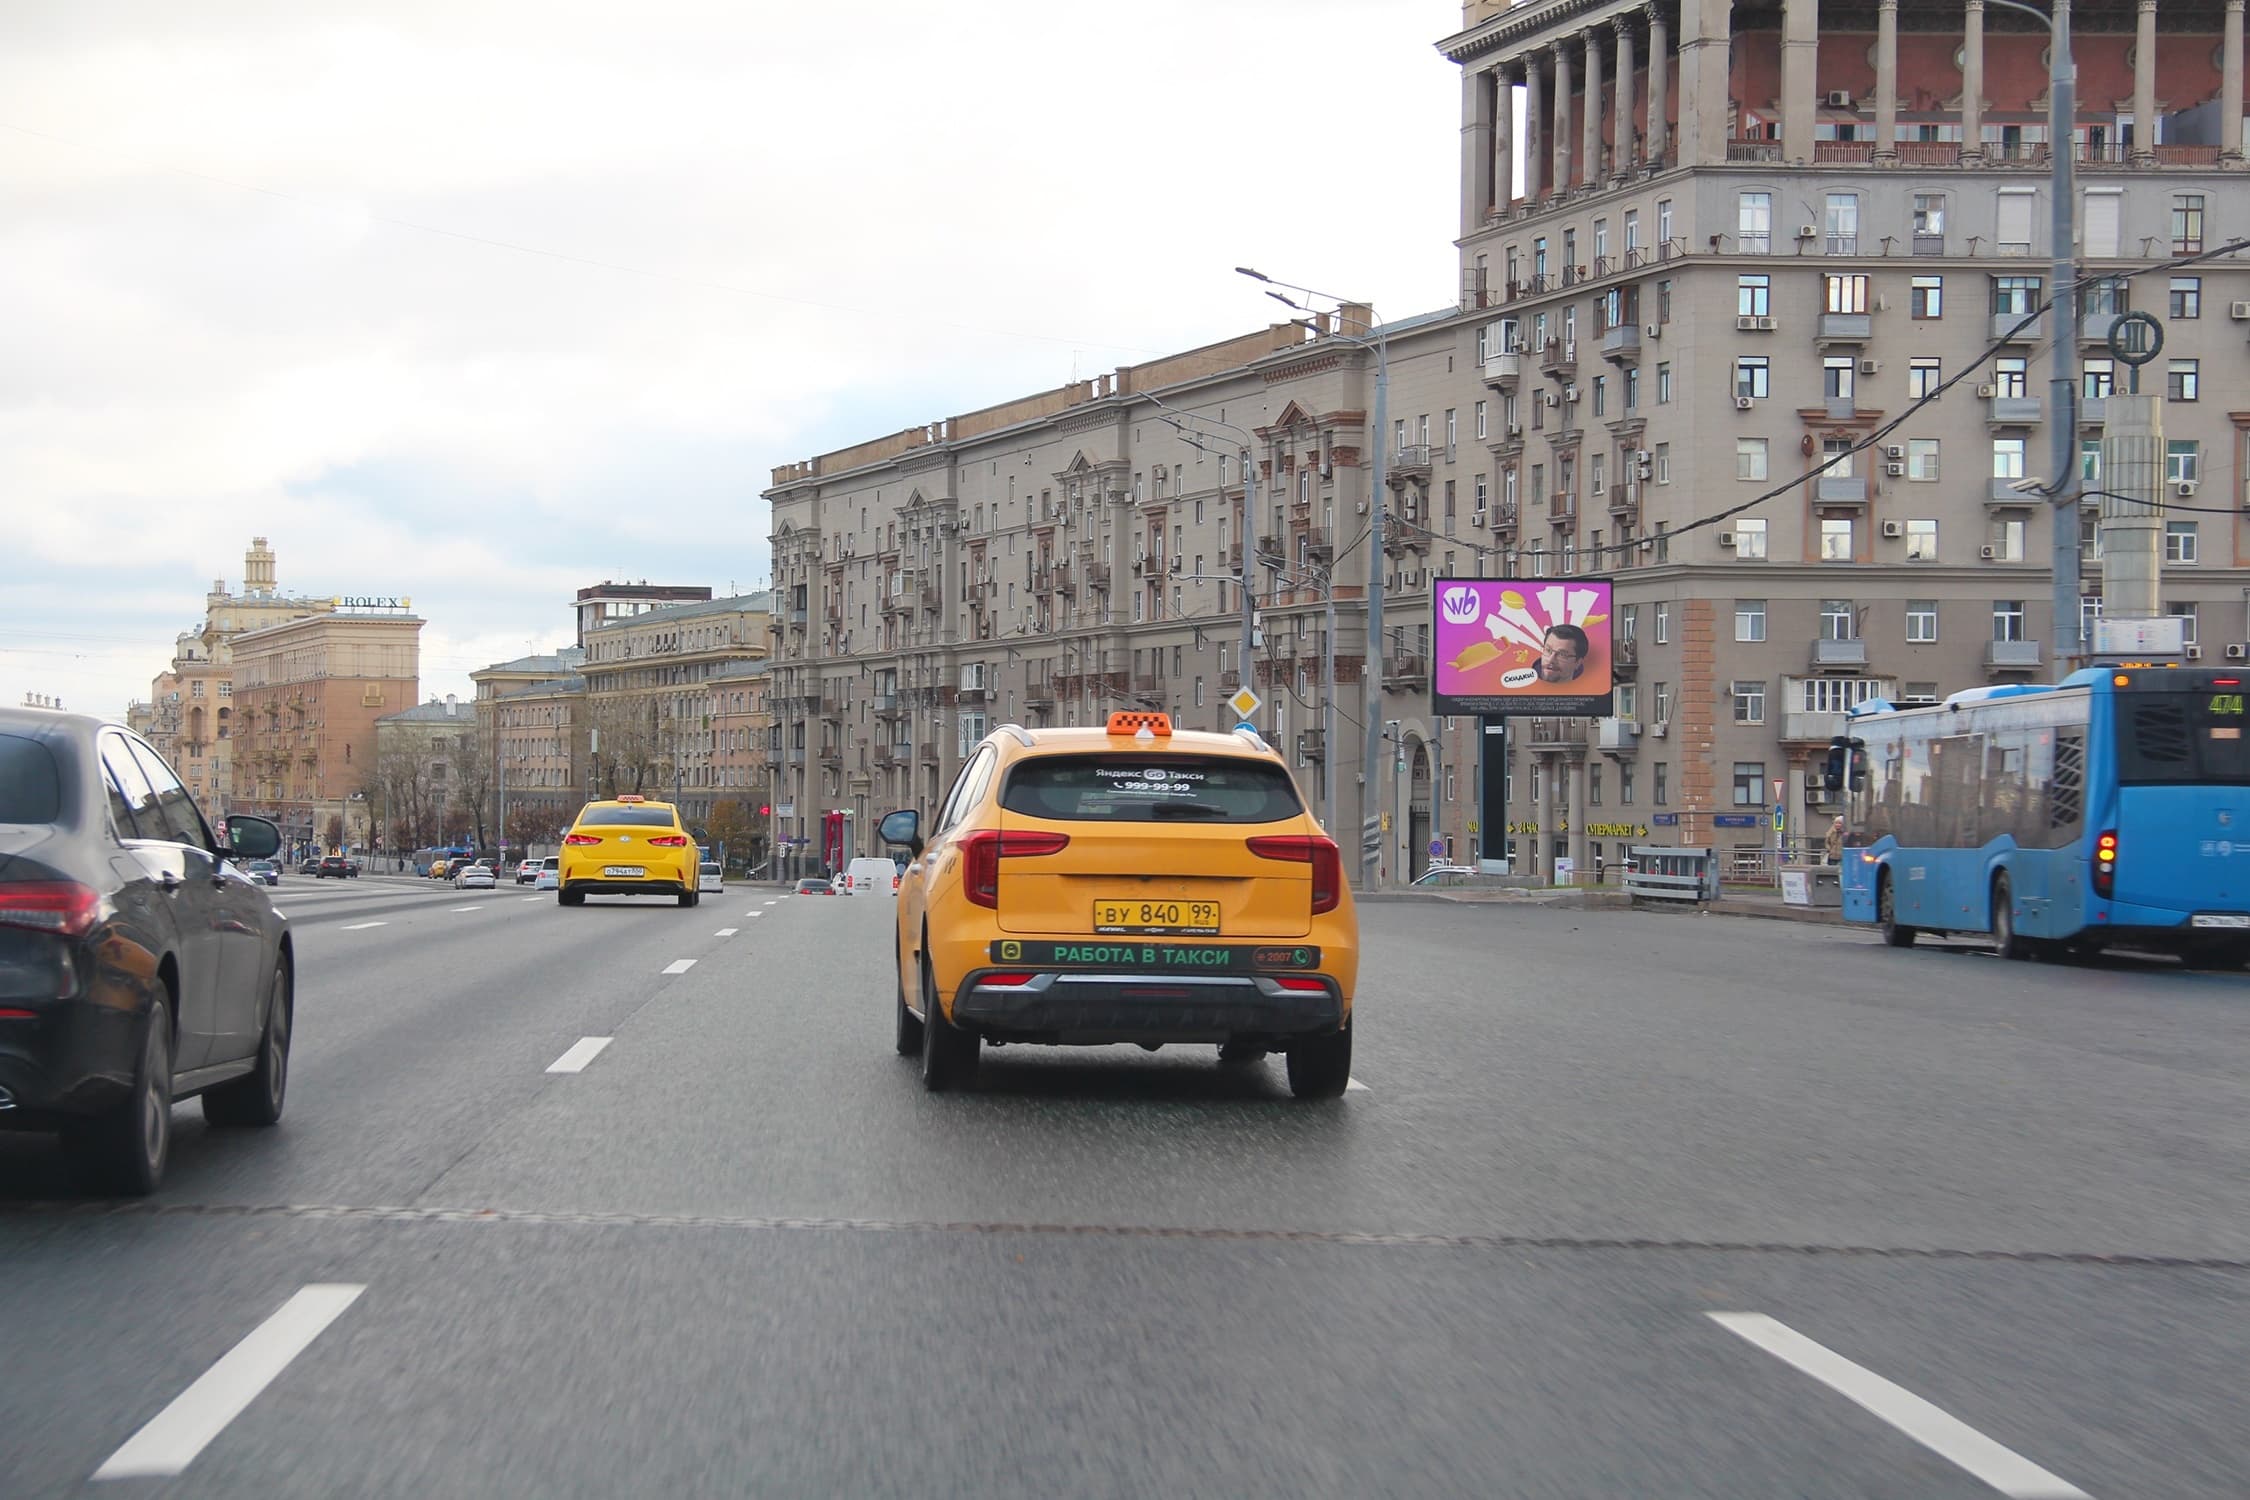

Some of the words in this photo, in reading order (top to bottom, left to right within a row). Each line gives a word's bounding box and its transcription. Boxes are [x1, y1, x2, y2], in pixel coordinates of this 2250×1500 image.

[344, 596, 398, 607] ROLEX
[2208, 694, 2244, 714] 474
[1095, 768, 1142, 778] Яндекс
[1168, 771, 1204, 780] Такси
[1124, 781, 1190, 791] 999-99-99
[1586, 823, 1634, 837] СУПЕРМАРКЕТ
[1105, 908, 1130, 922] ВУ
[1140, 904, 1179, 923] 840
[1191, 904, 1212, 919] 99
[1053, 946, 1135, 963] РАБОТА
[1142, 948, 1156, 963] В
[1162, 948, 1230, 965] ТАКСИ
